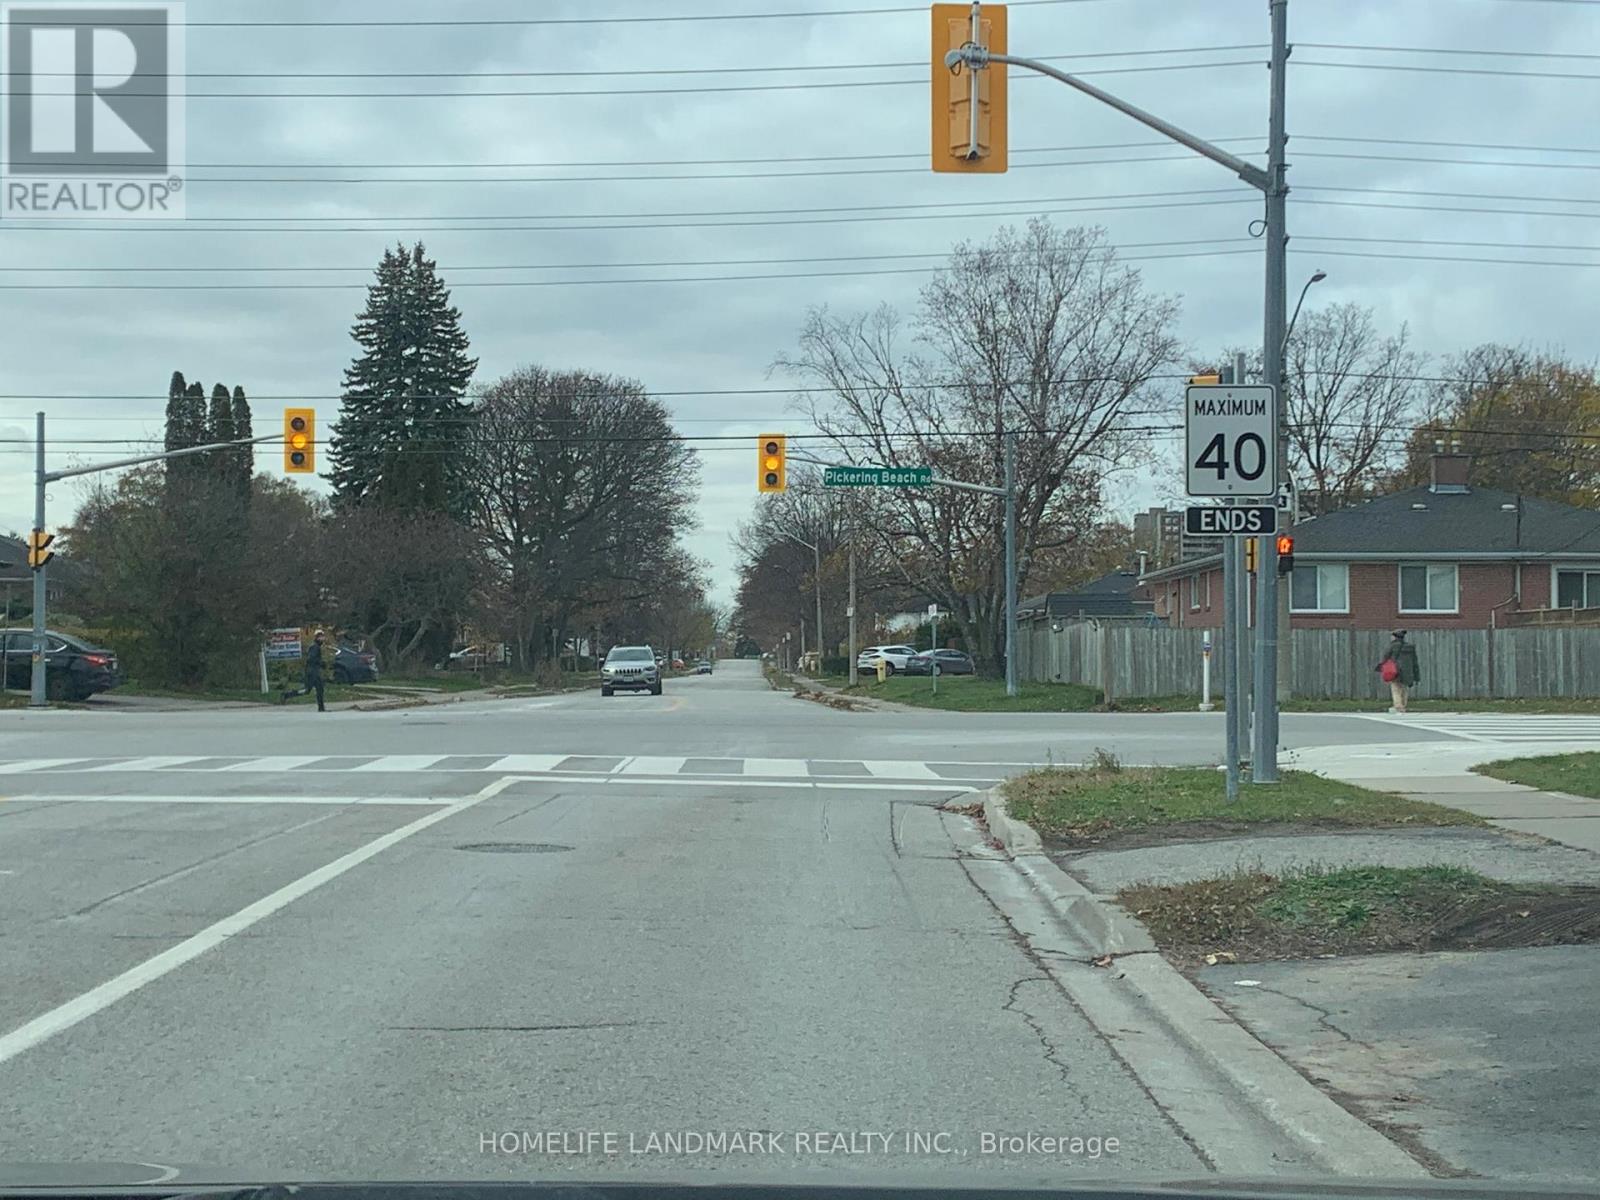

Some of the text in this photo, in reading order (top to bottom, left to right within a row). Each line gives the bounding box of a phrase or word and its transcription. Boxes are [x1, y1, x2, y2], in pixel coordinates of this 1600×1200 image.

[1194, 399, 1266, 416] MAXIMUM
[1194, 432, 1266, 481] 40
[825, 471, 878, 485] Pickering
[881, 471, 917, 483] Beach
[1200, 509, 1262, 531] ENDS
